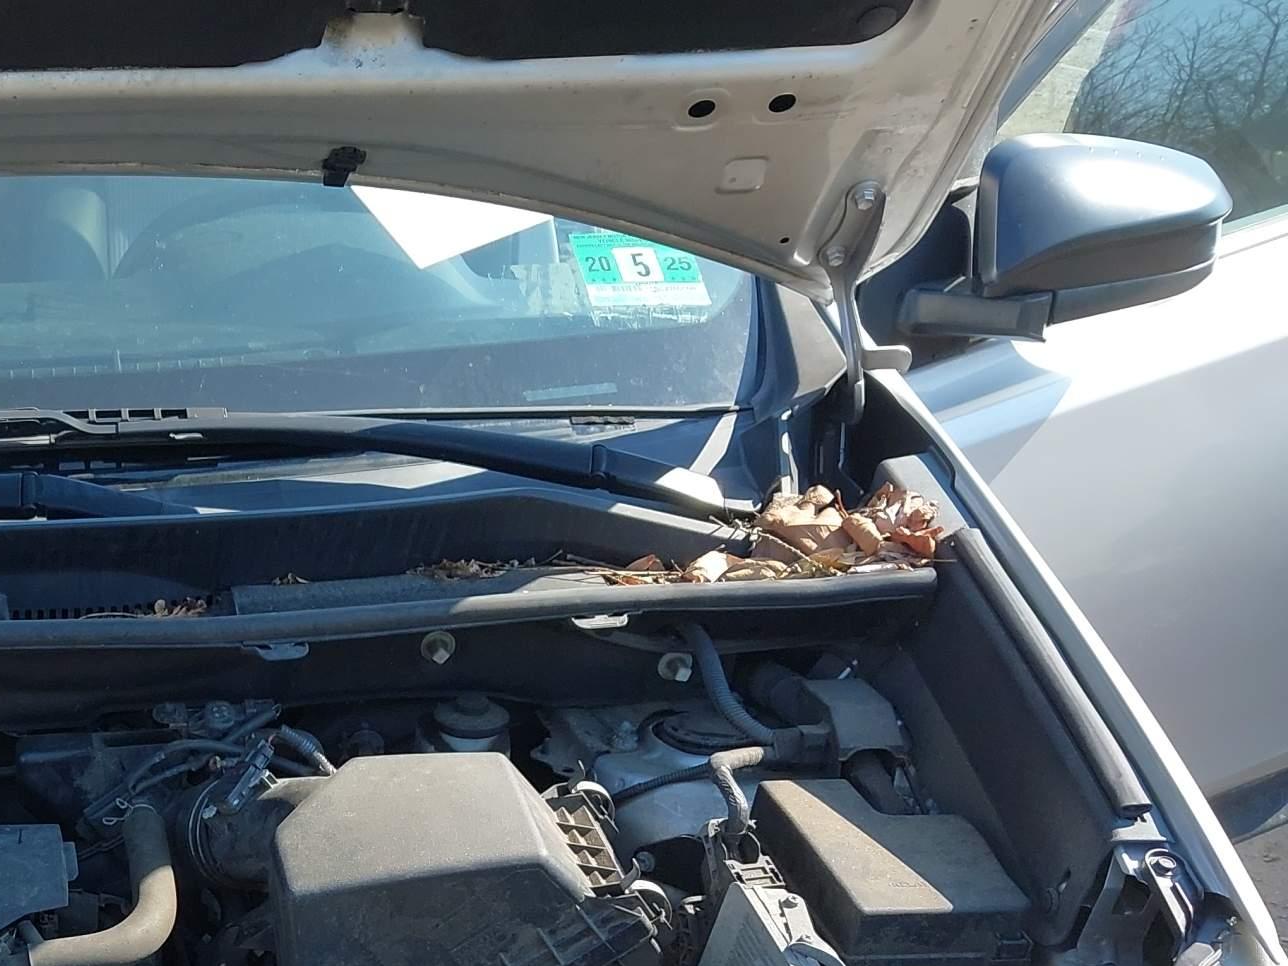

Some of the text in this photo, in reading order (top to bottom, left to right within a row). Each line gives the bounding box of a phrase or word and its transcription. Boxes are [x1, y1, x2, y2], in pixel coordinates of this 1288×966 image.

[585, 253, 692, 277] 20 5 25
